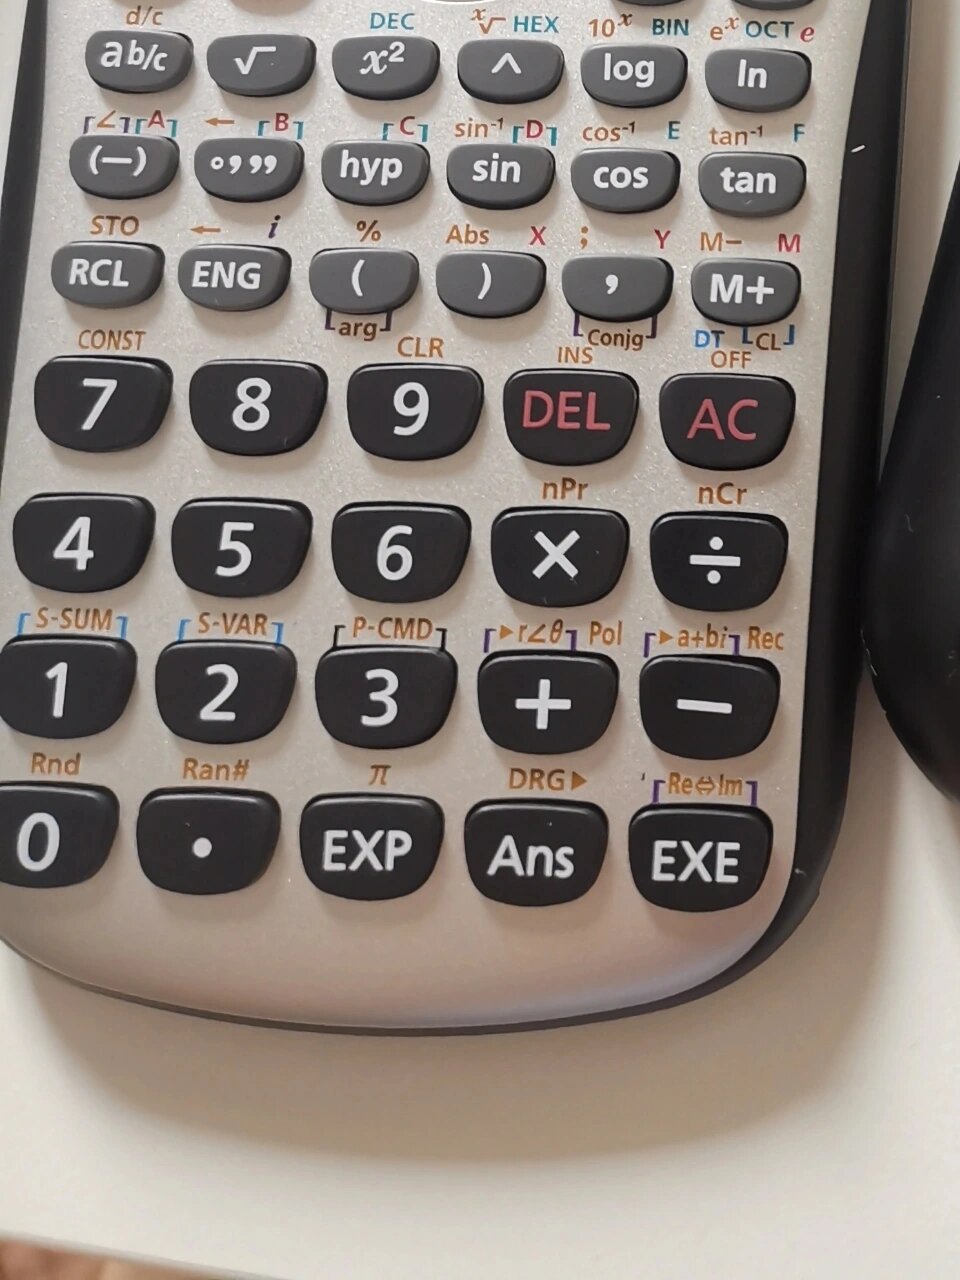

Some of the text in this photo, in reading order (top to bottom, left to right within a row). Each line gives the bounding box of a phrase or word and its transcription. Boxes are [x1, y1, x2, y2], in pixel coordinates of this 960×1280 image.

[126, 6, 163, 26] d/c
[370, 12, 415, 30] DEC
[513, 15, 560, 34] HEX
[652, 18, 689, 36] BIN
[745, 20, 795, 39] OCT
[603, 52, 655, 88] log
[667, 121, 681, 140] E
[793, 123, 805, 142] F
[340, 149, 403, 186] hyp
[472, 152, 521, 183] sin
[593, 165, 649, 189] cos
[720, 167, 777, 194] tan
[90, 215, 140, 236] STO
[356, 220, 381, 242] %
[446, 224, 547, 246] Abs X
[655, 229, 671, 250] Y
[778, 233, 801, 253] M
[68, 258, 130, 288] RCL
[191, 261, 262, 290] ENG
[709, 273, 775, 305] M+
[78, 329, 147, 351] CONST
[338, 319, 378, 342] arg
[587, 329, 644, 352] Conjg
[694, 330, 781, 351] DT CL
[397, 336, 445, 358] CLR
[558, 346, 594, 364] INS
[711, 350, 752, 369] OFF
[80, 377, 118, 431] 7
[232, 377, 272, 432] 8
[393, 381, 430, 436] 9
[522, 389, 611, 432] DEL
[686, 398, 759, 441] AC
[541, 477, 588, 500] nPr
[698, 482, 748, 506] nCr
[53, 516, 94, 571] 4
[215, 521, 255, 577] 5
[376, 524, 414, 582] 6
[35, 607, 113, 631] S-SUM
[197, 612, 269, 637] S-VAR
[352, 616, 434, 641] P-CMD
[589, 621, 623, 645] Pol
[747, 626, 785, 651] Rec
[45, 661, 69, 718] 1
[199, 663, 239, 722] 2
[360, 668, 399, 727] 3
[31, 752, 82, 776] Rnd
[182, 758, 250, 781] Ran#
[16, 812, 61, 872] 0
[321, 829, 413, 872] EXP
[486, 834, 575, 879] Ans
[651, 839, 741, 883] EXE
